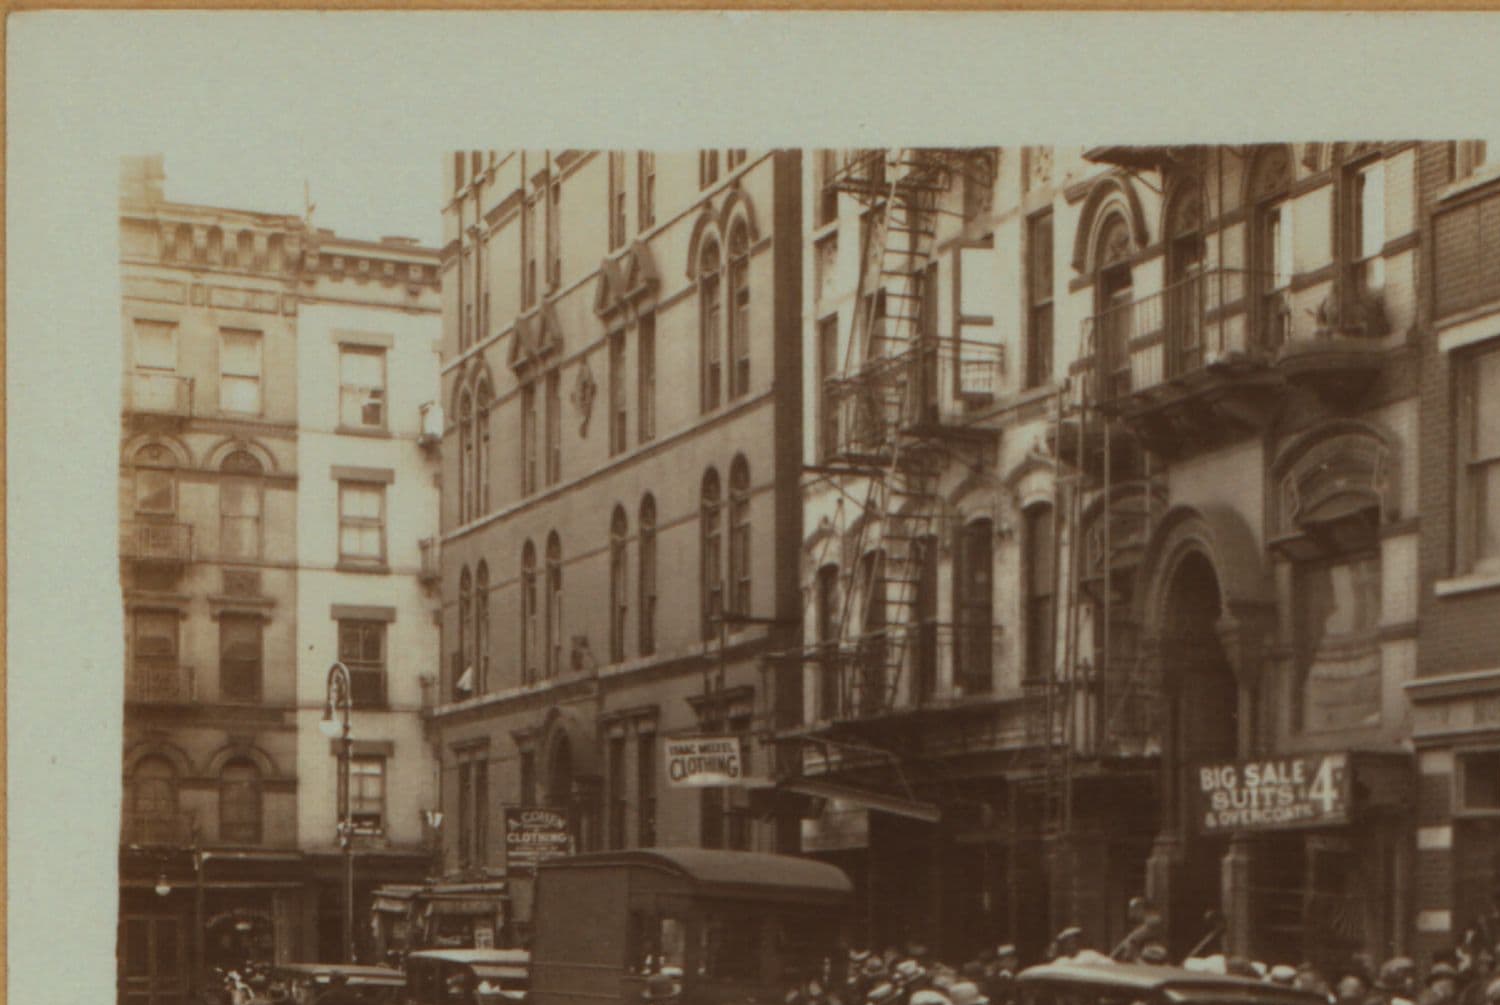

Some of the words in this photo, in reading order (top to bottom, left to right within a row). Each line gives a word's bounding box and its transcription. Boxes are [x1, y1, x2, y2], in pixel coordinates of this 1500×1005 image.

[670, 754, 739, 782] CLOTHING
[1200, 764, 1238, 791] BIG
[1244, 758, 1305, 788] SALE
[1211, 784, 1295, 811] SUITS
[506, 830, 568, 844] CLOTHING
